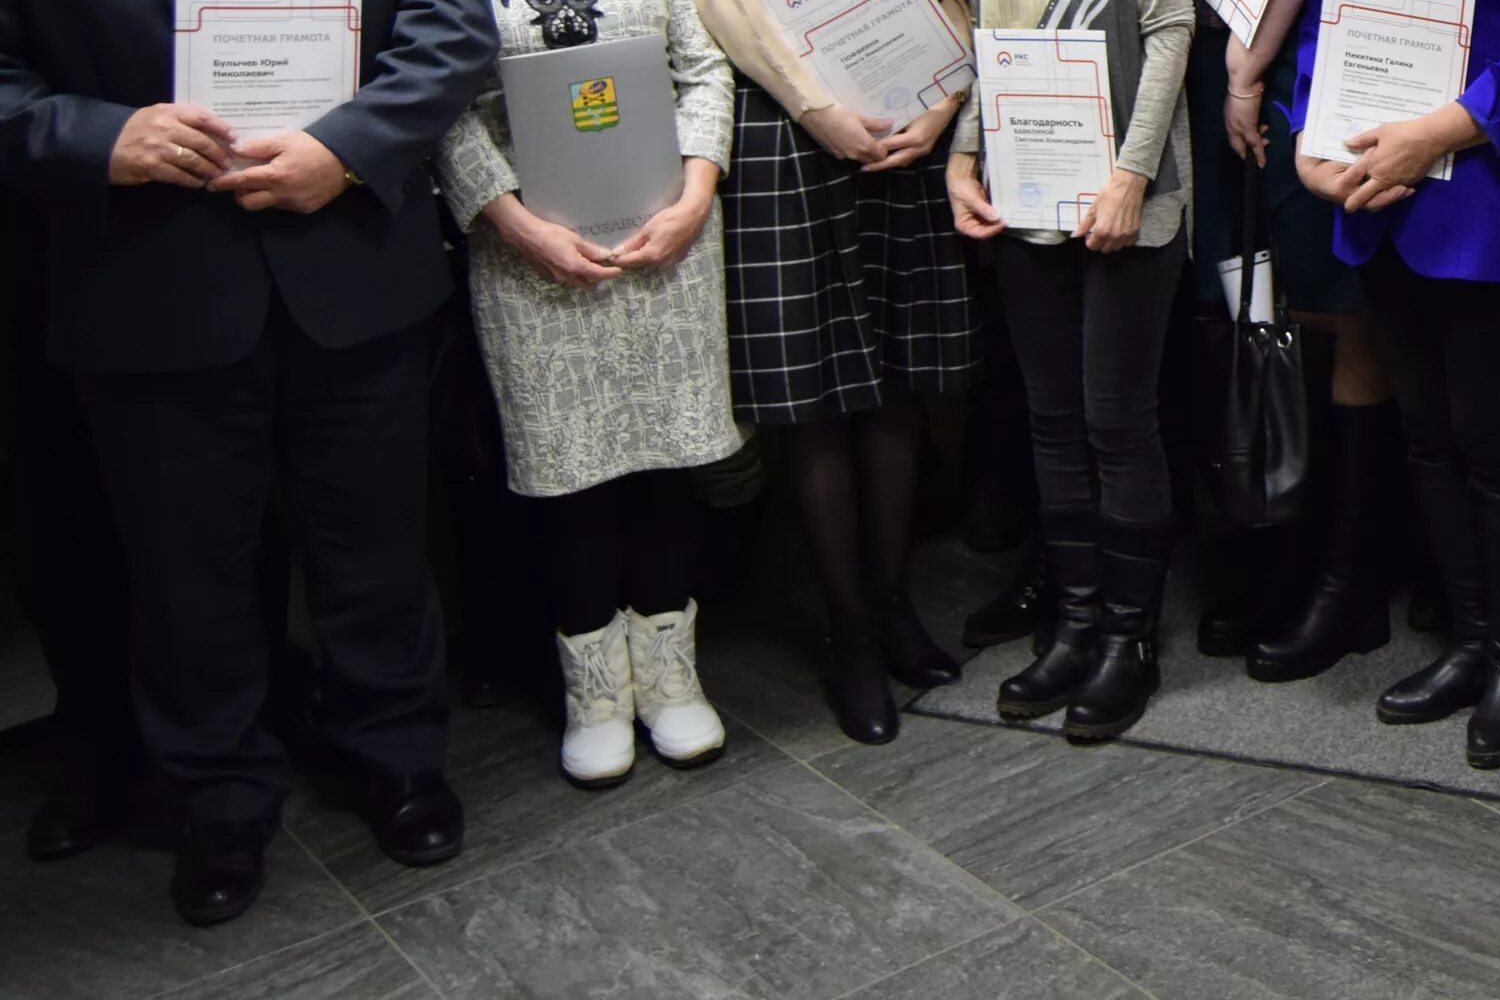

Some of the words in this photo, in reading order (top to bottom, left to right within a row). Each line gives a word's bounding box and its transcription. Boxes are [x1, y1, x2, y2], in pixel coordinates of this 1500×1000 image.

[213, 34, 277, 43] ПОЧЕТНАЯ
[280, 33, 331, 42] ГРАМОТА
[1347, 29, 1398, 44] ПОЧЕТНАЯ
[1399, 38, 1442, 52] ГРАМОТА
[213, 59, 258, 70] Булычев
[260, 58, 289, 68] Юрий
[1345, 51, 1384, 63] Никитина
[1385, 57, 1414, 69] Галина
[1343, 60, 1389, 74] Евгеньевна
[213, 70, 275, 78] Николаевич
[1010, 117, 1084, 128] Благодарность
